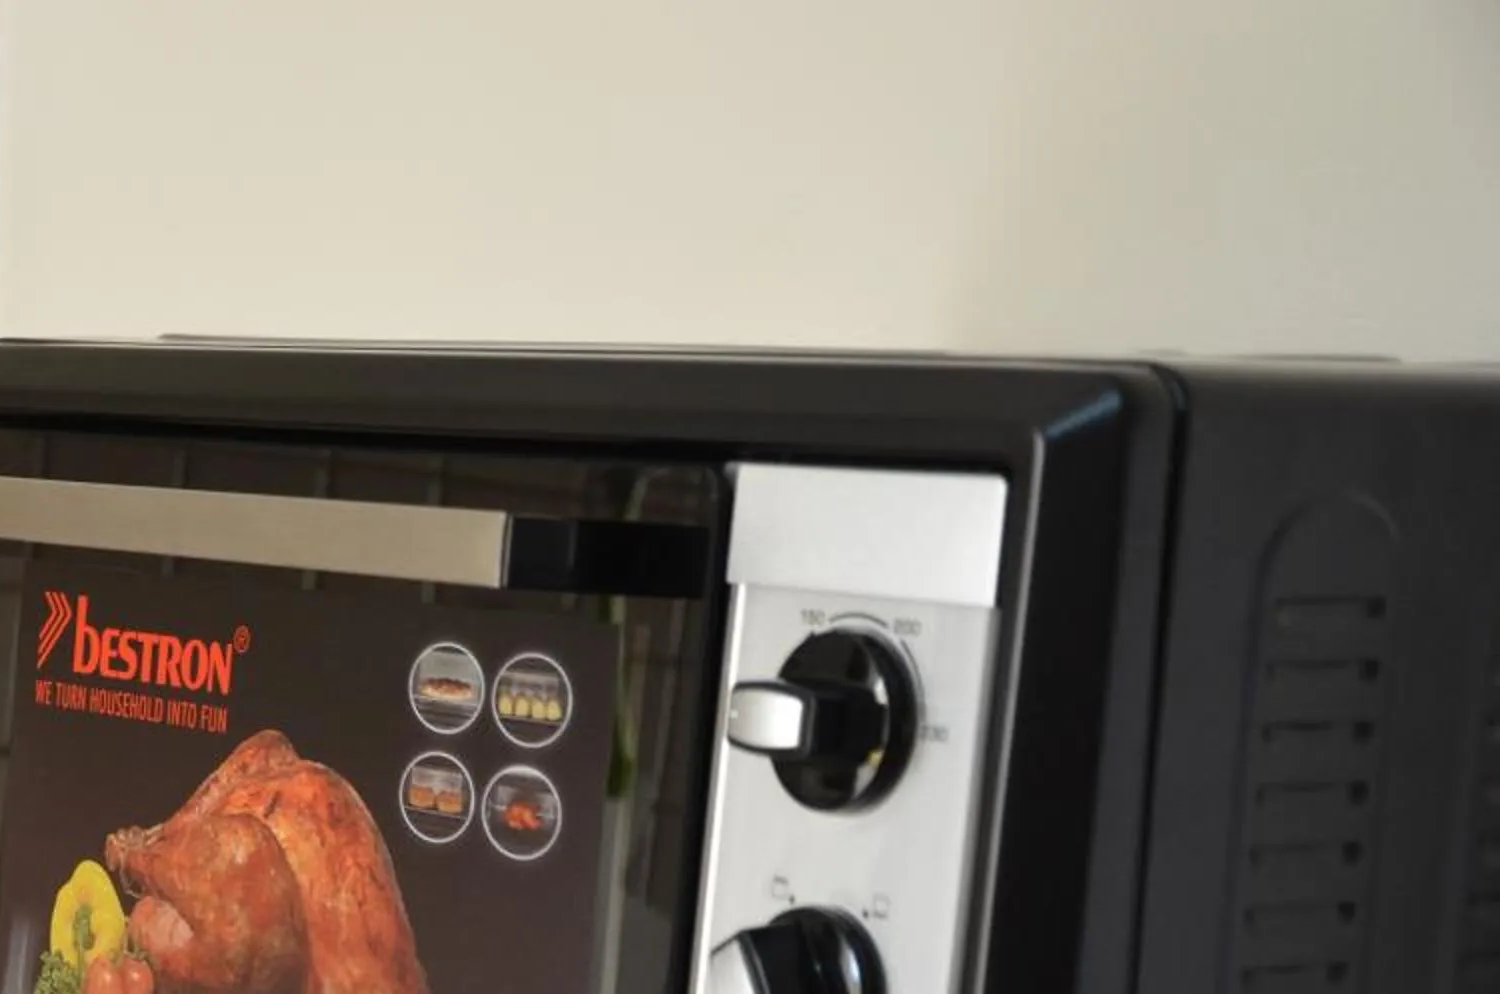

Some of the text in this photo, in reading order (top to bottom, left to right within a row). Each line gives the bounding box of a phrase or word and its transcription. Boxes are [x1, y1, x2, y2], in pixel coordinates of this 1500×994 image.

[35, 679, 228, 736] WE TURN HOUSEHOLD INTO FUN
